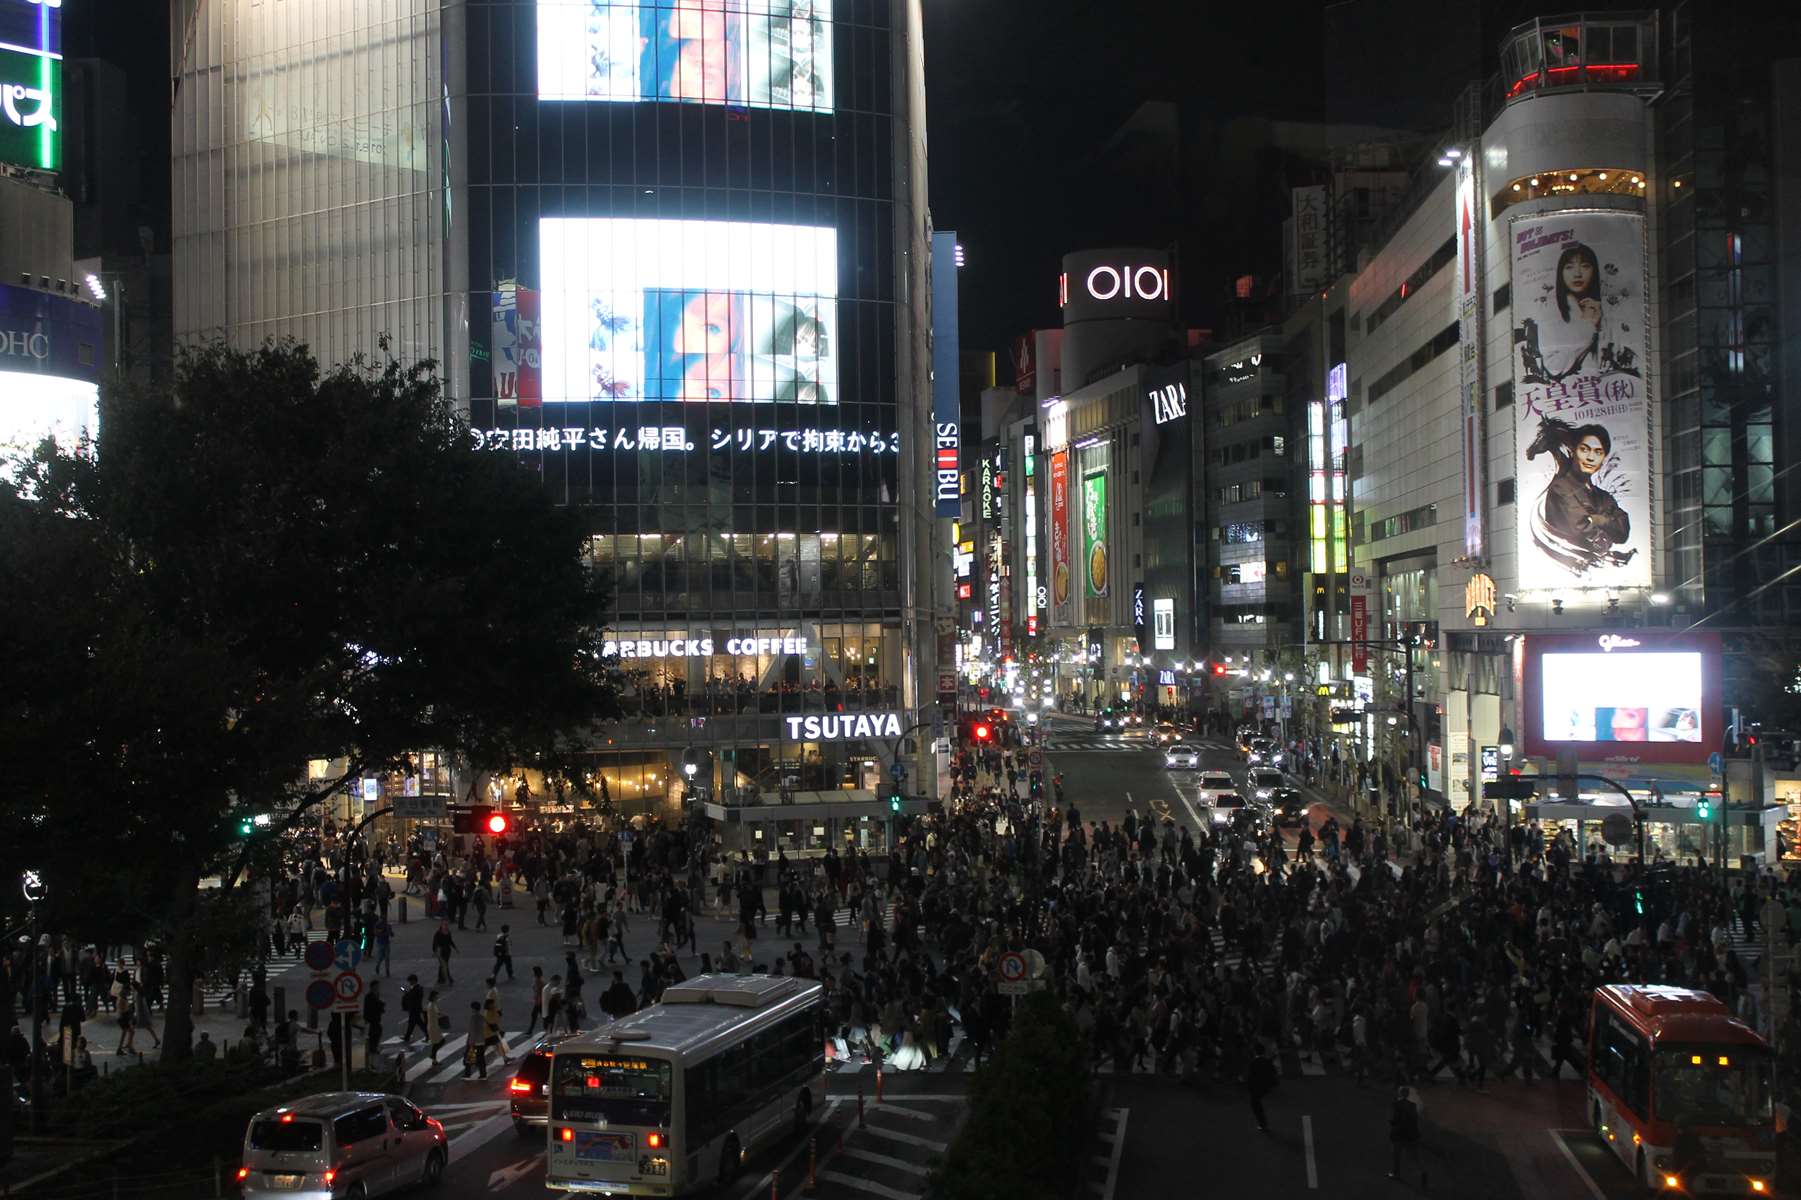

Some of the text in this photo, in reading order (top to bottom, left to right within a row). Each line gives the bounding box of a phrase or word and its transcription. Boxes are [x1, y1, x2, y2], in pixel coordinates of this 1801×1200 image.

[982, 458, 993, 519] KARAOKE
[1135, 589, 1144, 625] ZARA
[594, 637, 808, 658] ARBUCKS COFFEE
[787, 713, 901, 740] TSUTAYA
